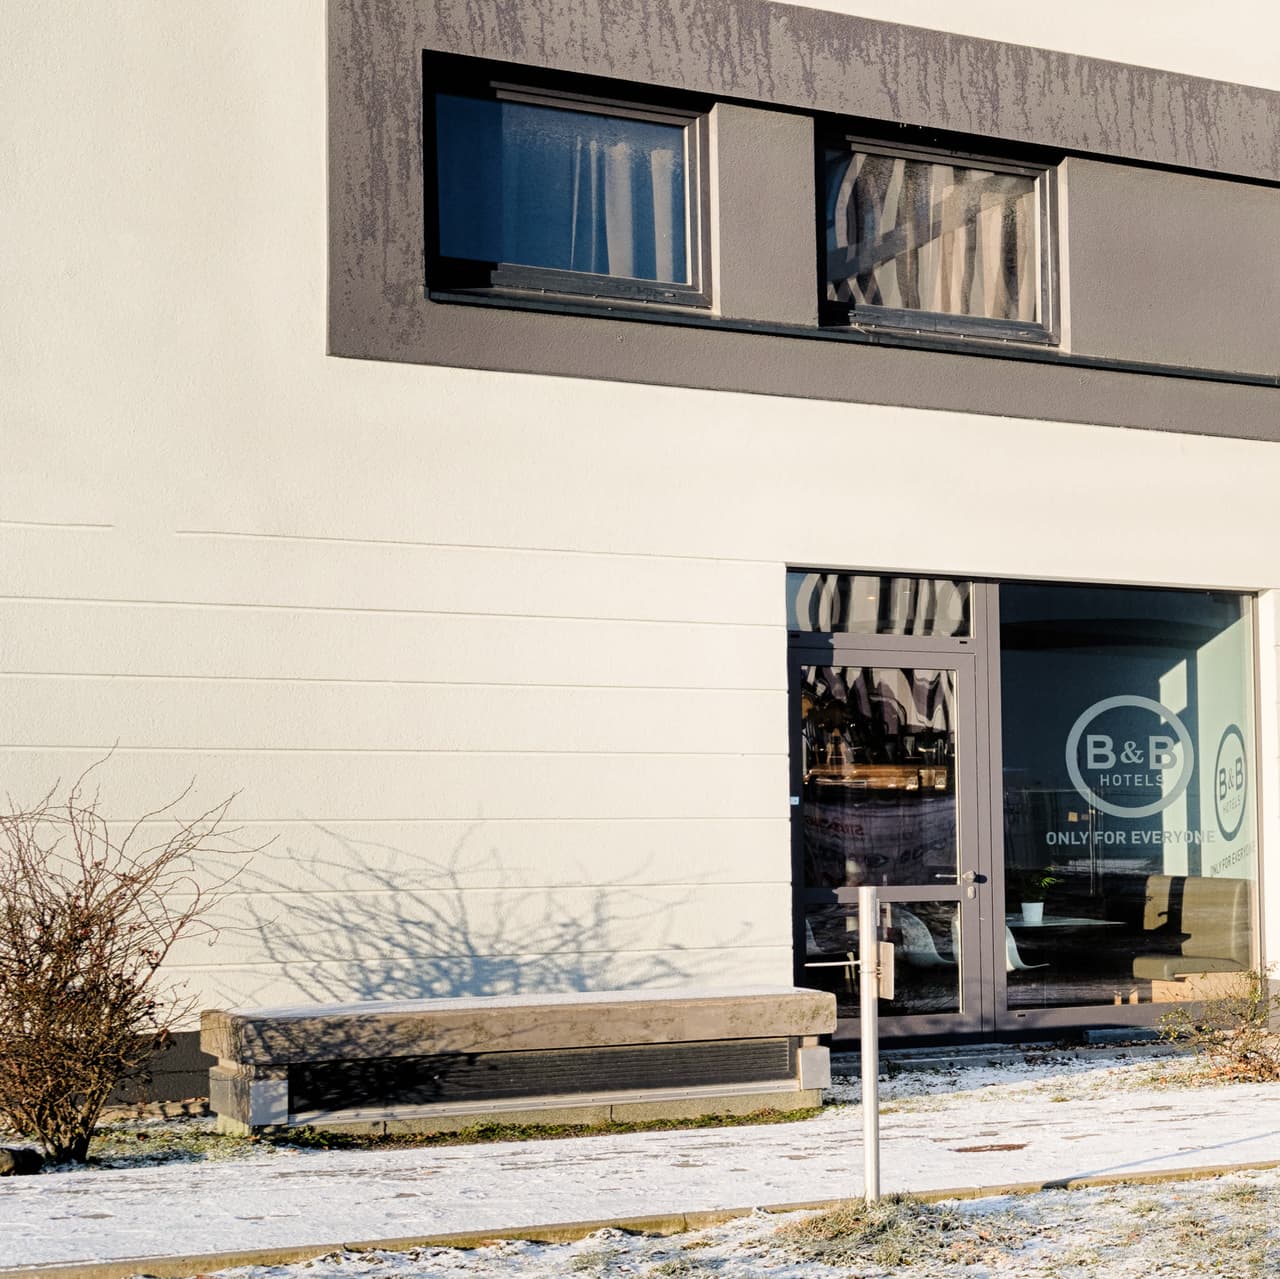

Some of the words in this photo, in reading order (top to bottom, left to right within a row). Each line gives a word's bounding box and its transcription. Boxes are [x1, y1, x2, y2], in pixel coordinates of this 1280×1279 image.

[1086, 734, 1178, 770] B&B
[1100, 774, 1165, 787] HOTELS
[1219, 757, 1244, 801] B&B
[1045, 831, 1090, 845] ONLY
[1094, 831, 1127, 845] FOR
[1131, 831, 1217, 845] EVERYONE
